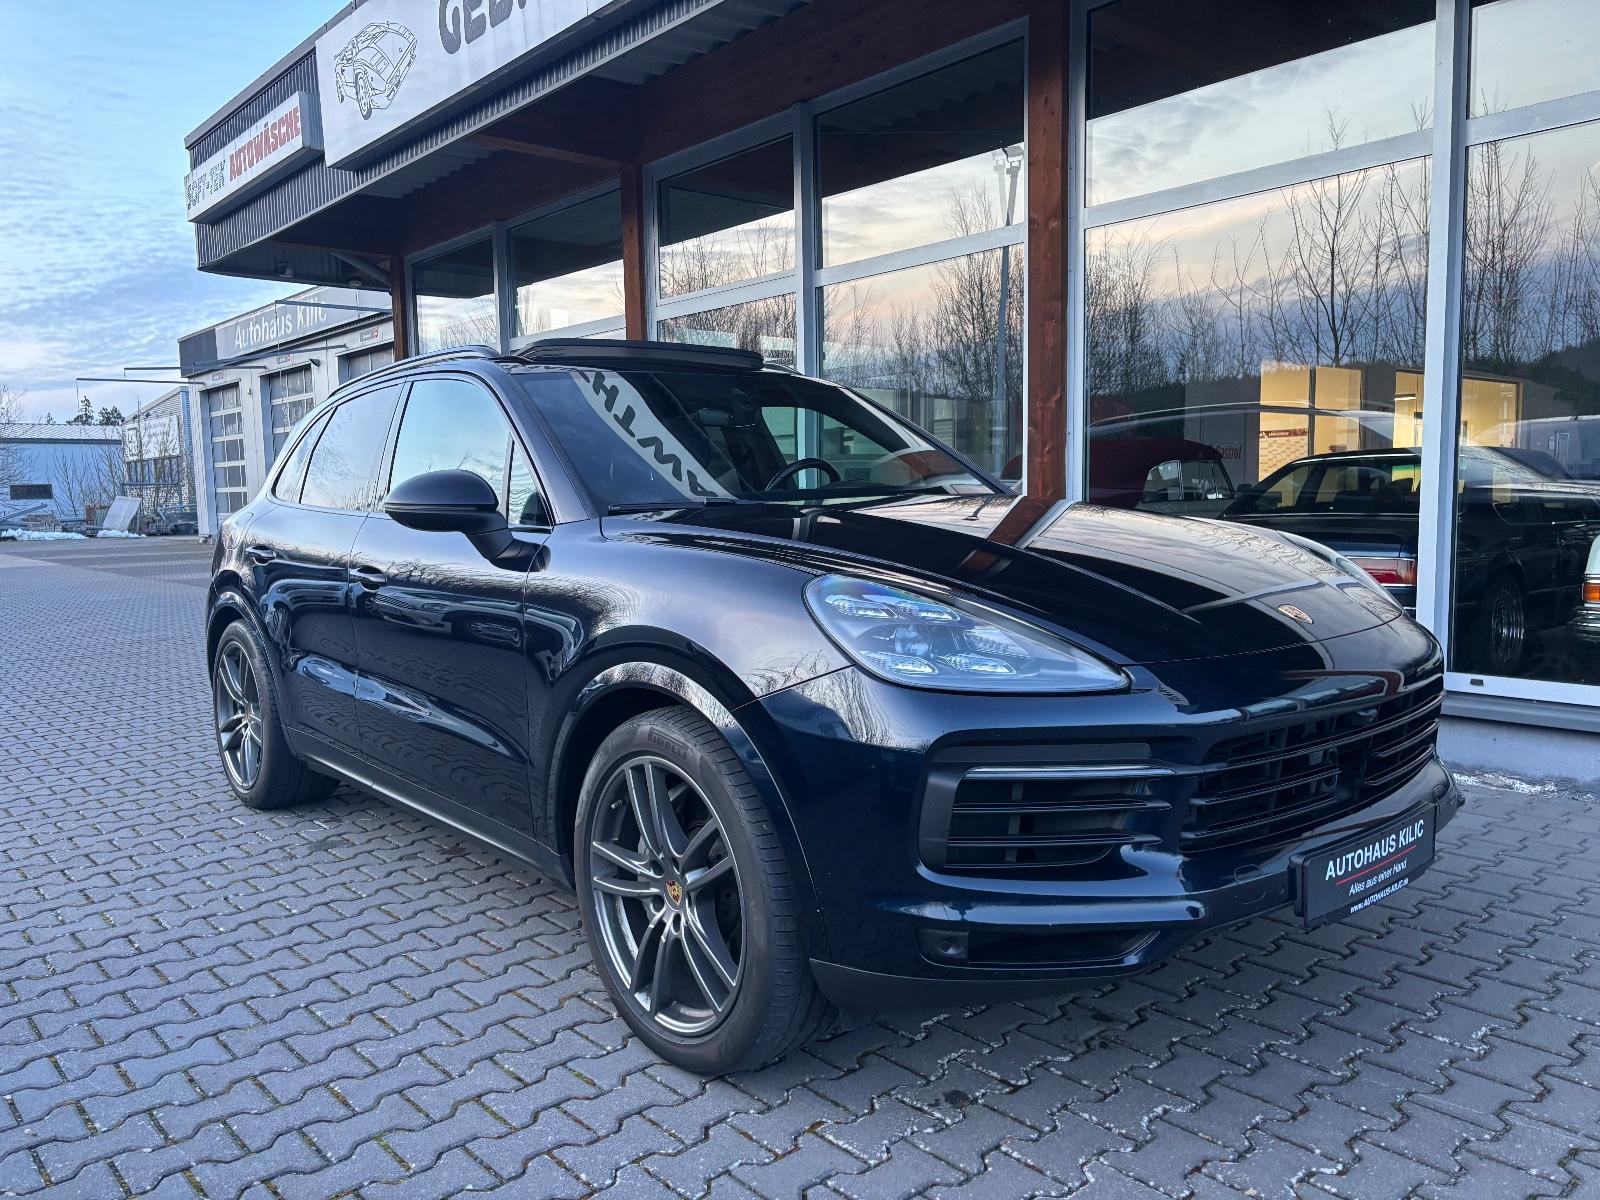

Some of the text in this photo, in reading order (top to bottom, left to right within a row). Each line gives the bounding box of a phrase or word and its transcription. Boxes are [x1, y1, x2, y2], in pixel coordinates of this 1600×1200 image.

[229, 106, 301, 182] AUTOWÄSCHE
[234, 313, 293, 350] Autohaus
[1325, 819, 1425, 881] AUTOHAUS KILIC
[1348, 858, 1408, 897] Alles aus einer Hand
